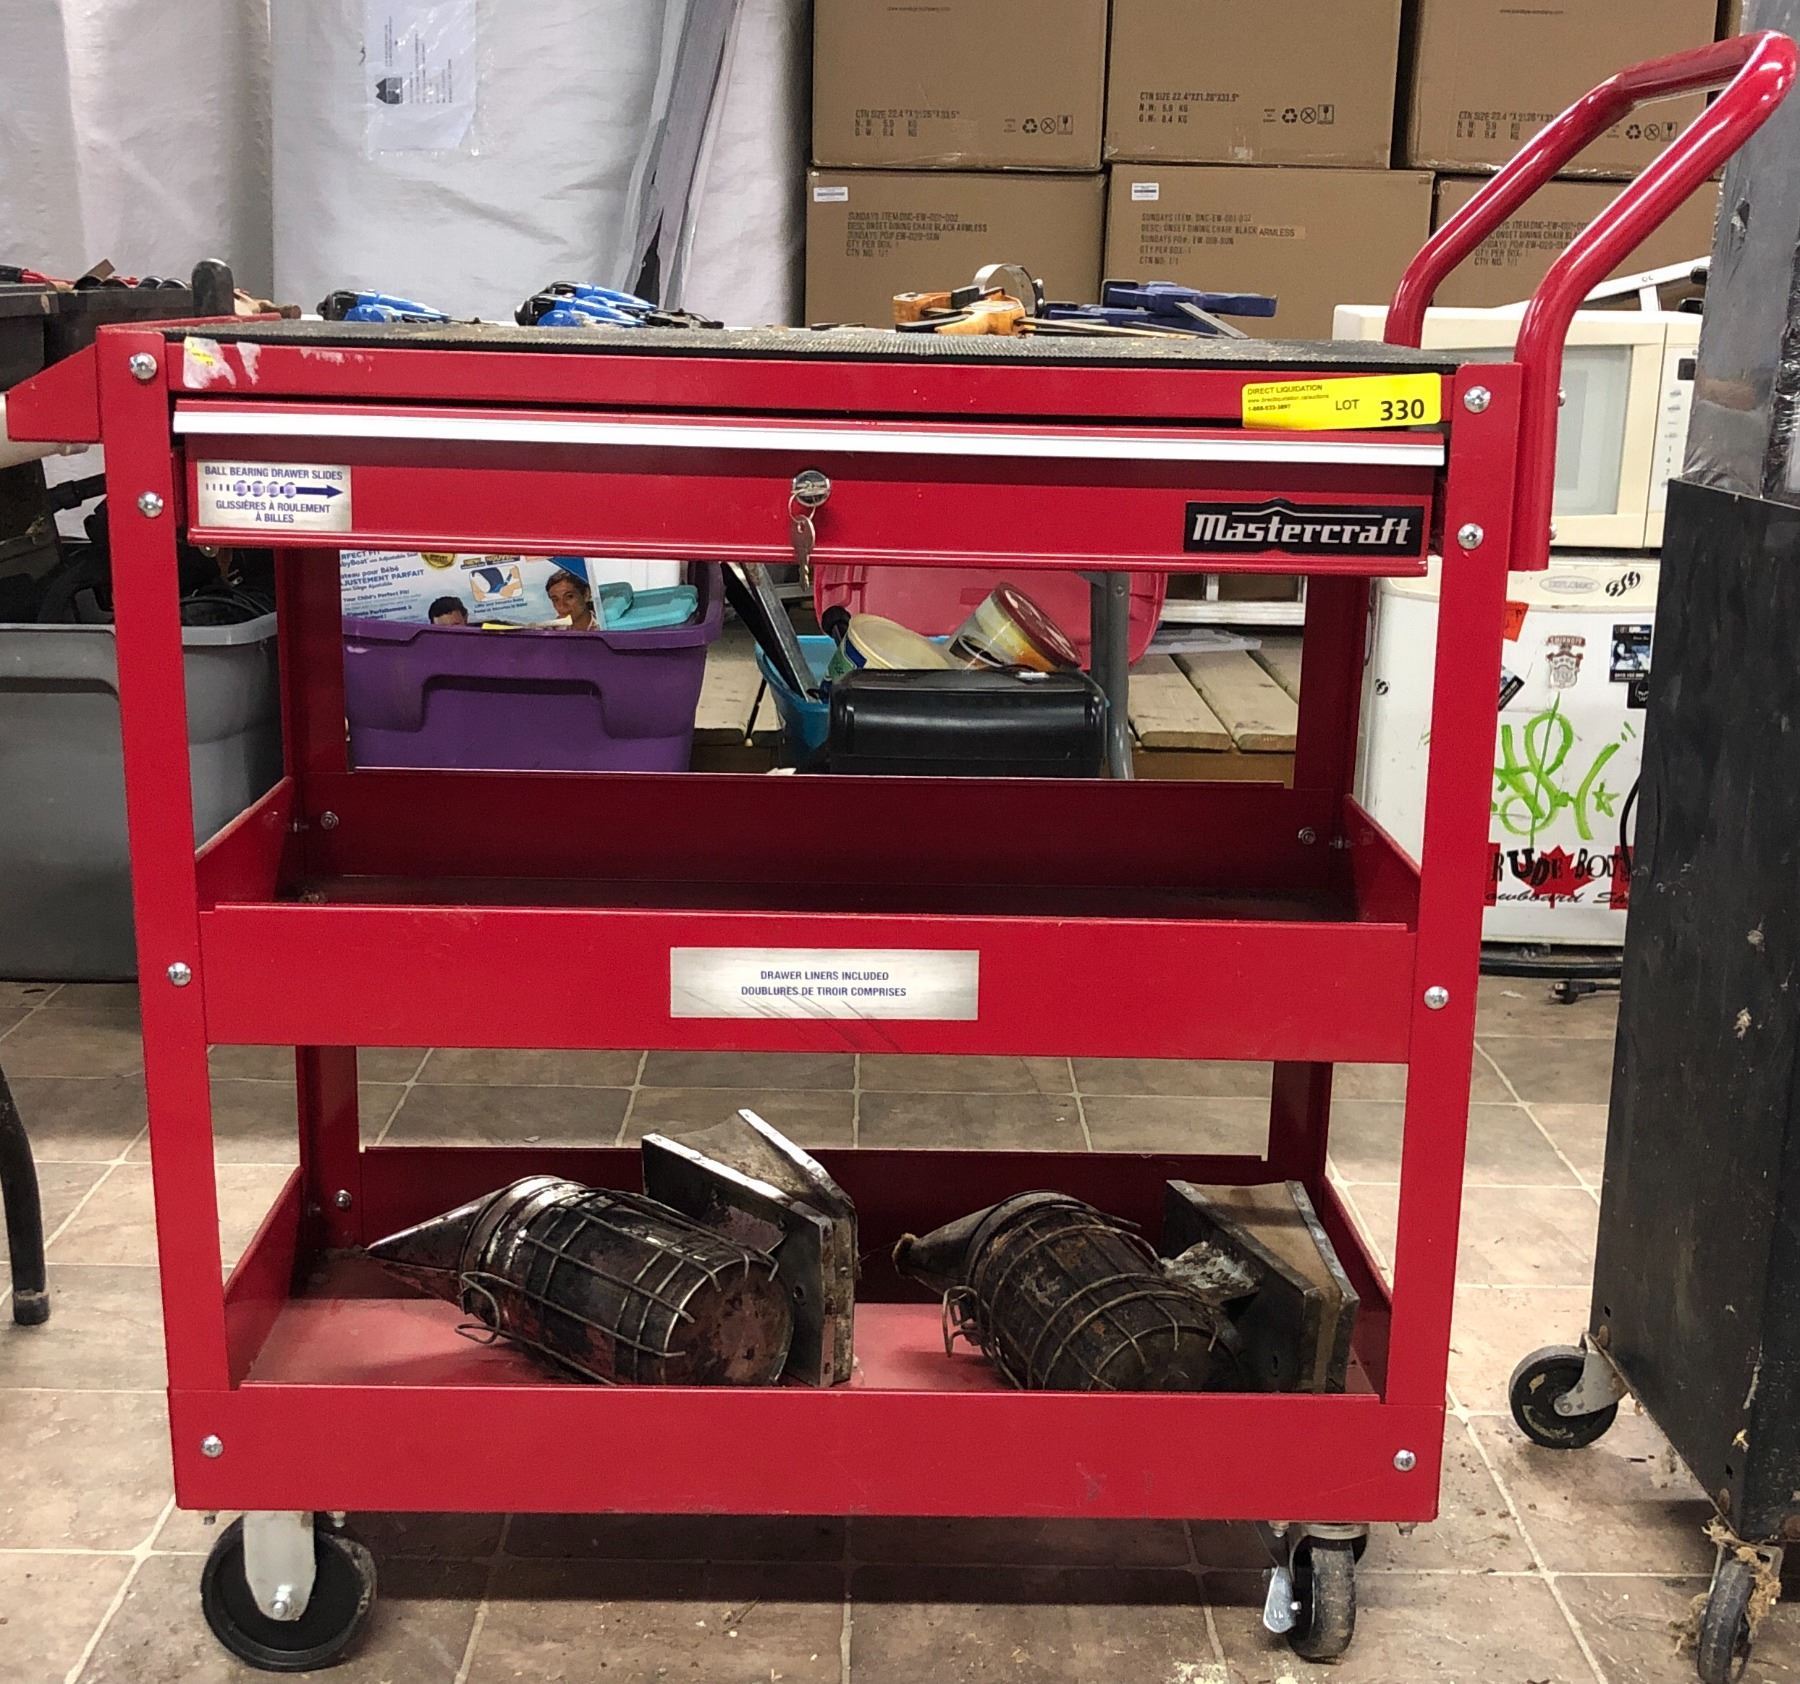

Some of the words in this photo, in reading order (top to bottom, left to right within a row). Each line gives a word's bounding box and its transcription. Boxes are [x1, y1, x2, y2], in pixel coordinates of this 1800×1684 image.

[1142, 213, 1173, 222] SUNDAYS
[913, 223, 932, 231] CHAIR
[934, 223, 956, 232] BLACK
[956, 223, 987, 233] ARMLESS
[1188, 224, 1209, 233] DINING
[1209, 225, 1232, 233] CHAIR
[1235, 226, 1257, 234] BLACK
[1259, 228, 1295, 237] ARMLESS
[1141, 234, 1172, 243] SUNDAYS
[1543, 231, 1564, 239] CHAIR
[862, 240, 875, 249] PER
[1155, 245, 1167, 254] PER
[1248, 386, 1274, 395] DIRECT
[1276, 384, 1323, 393] LIQUIDATION
[1336, 399, 1360, 411] LOT
[1380, 399, 1424, 421] 330
[205, 466, 226, 476] BALL
[230, 467, 268, 477] BEARING
[271, 469, 309, 479] DRAWER
[312, 470, 343, 480] SLIDES
[269, 500, 275, 511] À
[277, 503, 330, 513] ROULEMENT
[256, 512, 262, 522] À
[264, 513, 294, 523] BILLES
[1193, 514, 1411, 545] Mastercraft
[341, 575, 389, 586] JUSTEMENT
[392, 569, 424, 579] PARFAIT
[760, 971, 802, 980] DRAWER
[805, 971, 839, 980] LINERS
[842, 971, 889, 980] INCLUDED
[741, 986, 799, 996] DOUBLURES
[802, 987, 815, 996] DE
[817, 987, 848, 996] TIROIR
[851, 987, 907, 997] COMPRISES
